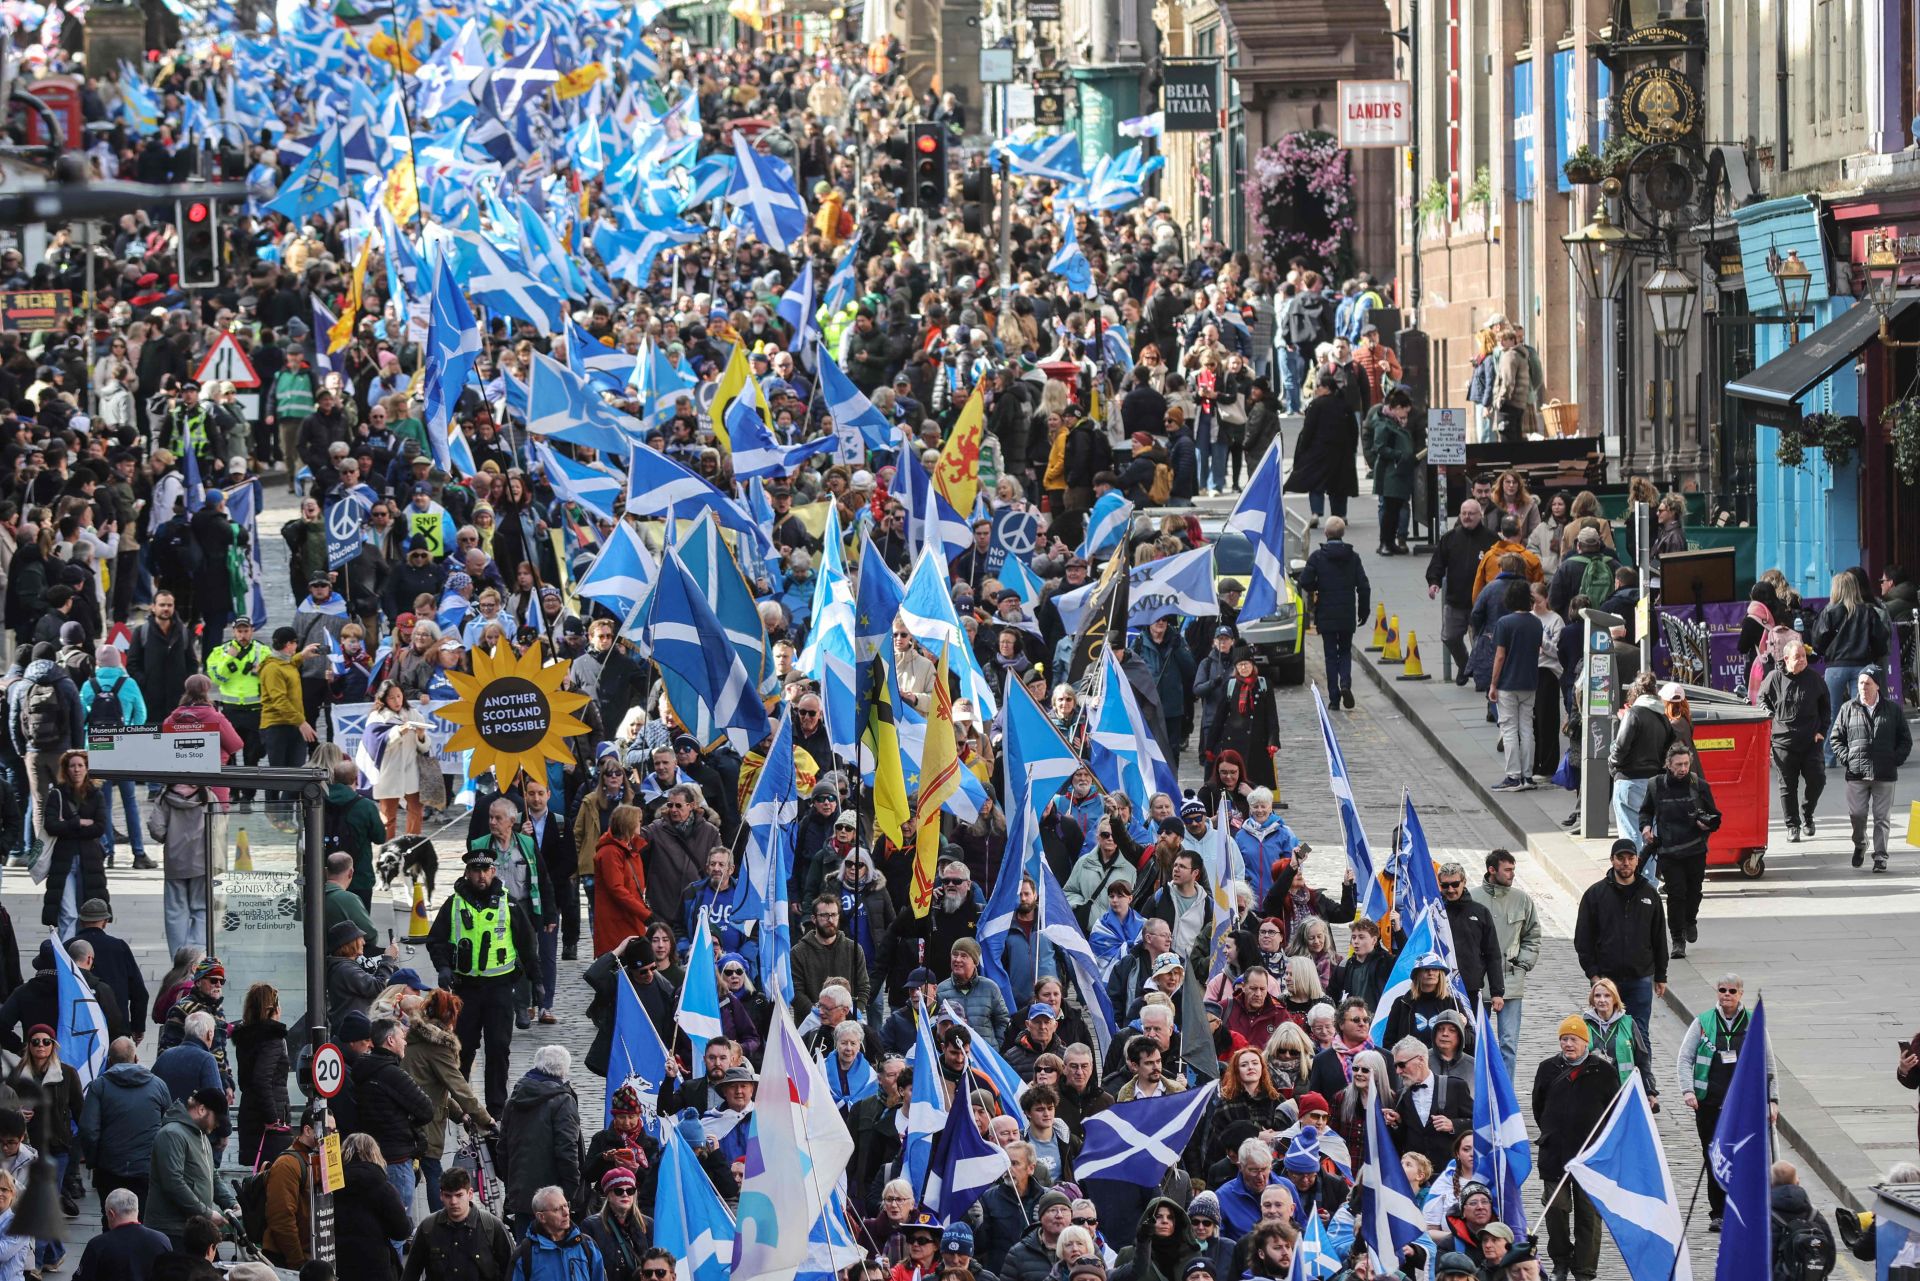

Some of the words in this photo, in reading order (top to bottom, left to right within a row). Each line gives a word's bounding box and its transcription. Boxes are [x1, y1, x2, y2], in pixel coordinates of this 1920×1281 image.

[1627, 27, 1688, 43] NICHOLSON'S
[1645, 68, 1672, 78] THE
[1166, 84, 1210, 98] BELLA
[1167, 99, 1212, 113] ITALIA
[1348, 101, 1402, 119] LANDY'S
[415, 516, 438, 526] SNP
[328, 542, 341, 553] No
[329, 541, 360, 562] Nuclear
[989, 547, 1005, 557] No
[1596, 631, 1609, 651] P
[1720, 665, 1745, 675] LIVE
[484, 693, 537, 708] ANOTHER
[482, 706, 541, 721] SCOTLAND
[126, 725, 158, 733] Childhood
[481, 725, 492, 735] IS
[494, 719, 547, 734] POSSIBLE
[188, 751, 204, 759] Stop
[245, 913, 281, 921] Transport
[244, 922, 255, 930] for
[256, 922, 296, 931] Edinburgh
[317, 1059, 340, 1081] 20
